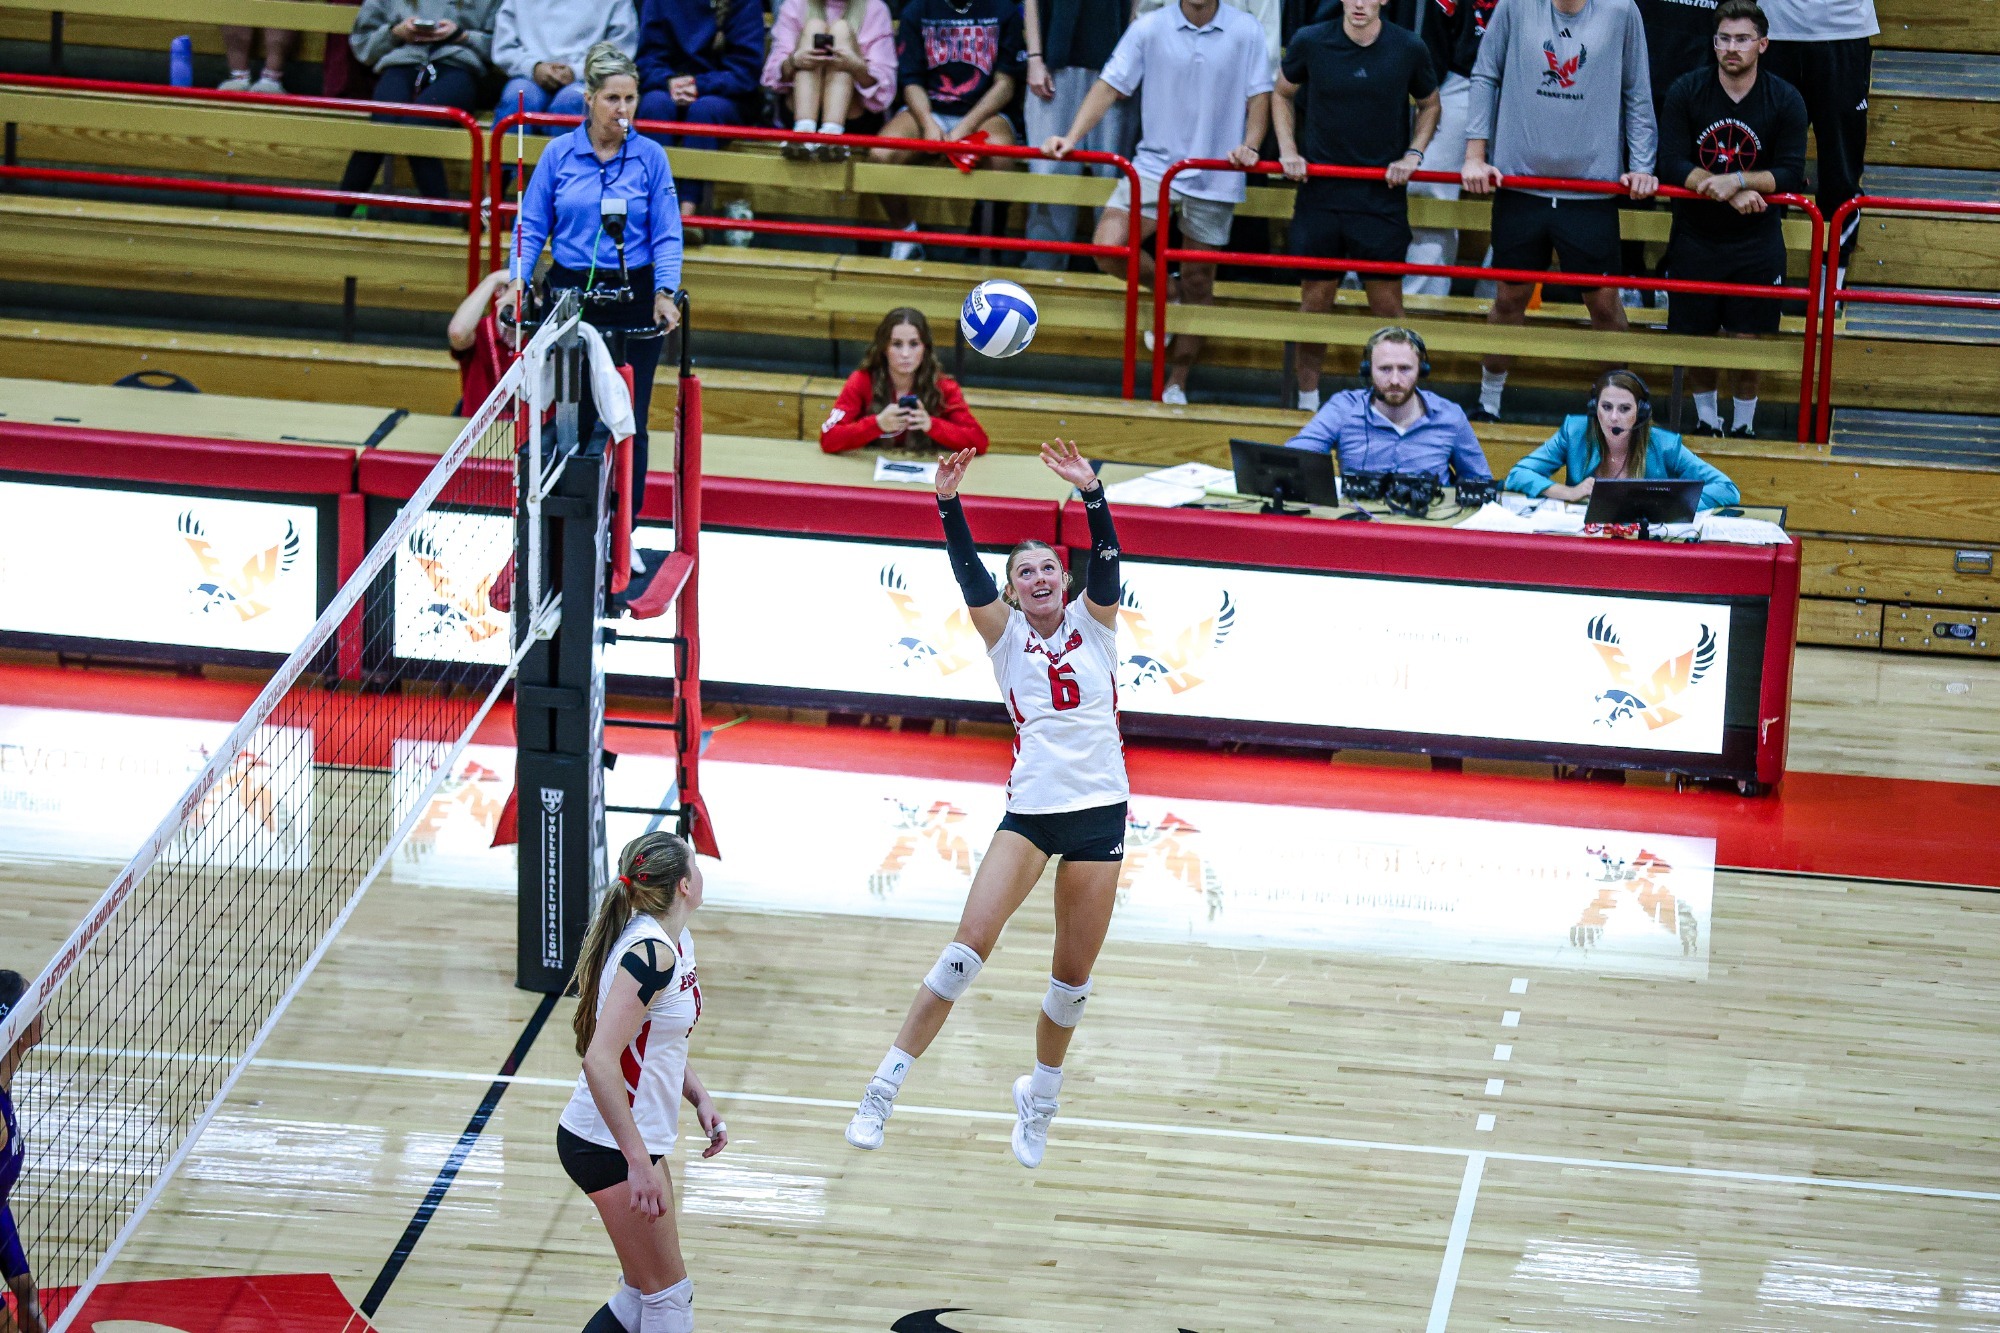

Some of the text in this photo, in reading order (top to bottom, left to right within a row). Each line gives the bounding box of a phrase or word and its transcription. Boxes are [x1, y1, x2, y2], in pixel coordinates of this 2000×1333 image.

[1047, 661, 1081, 712] 6
[37, 867, 136, 1008] EASTERN WASHINGTON
